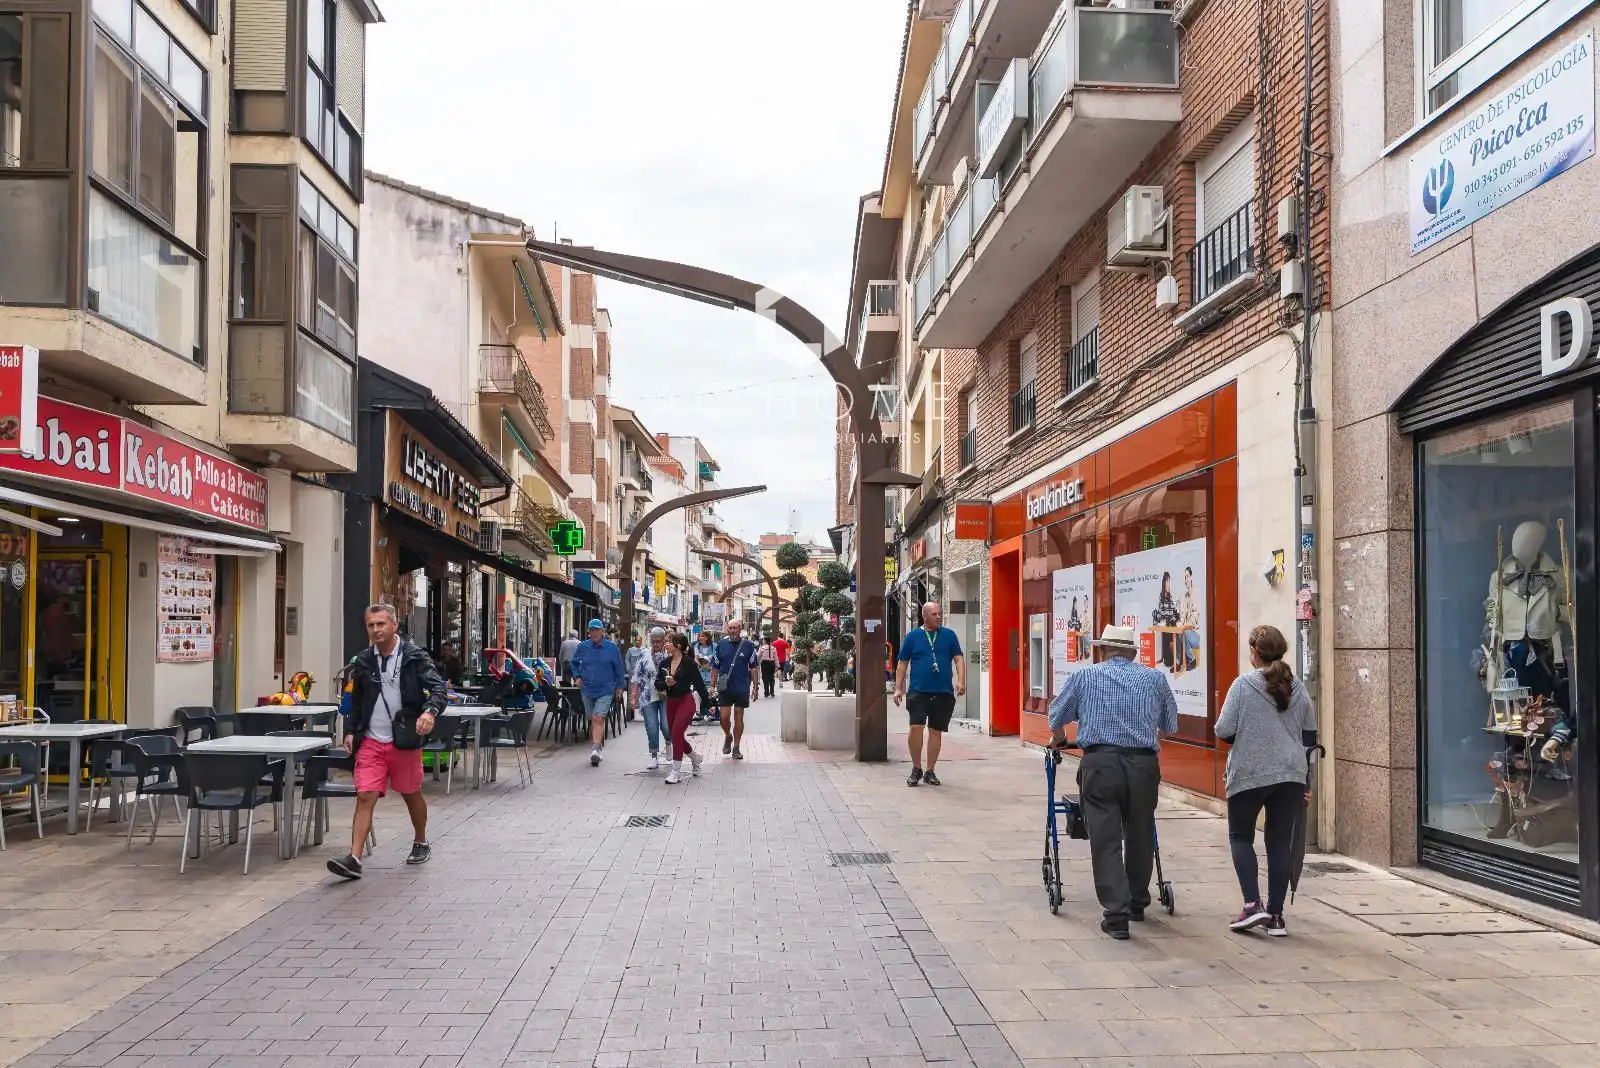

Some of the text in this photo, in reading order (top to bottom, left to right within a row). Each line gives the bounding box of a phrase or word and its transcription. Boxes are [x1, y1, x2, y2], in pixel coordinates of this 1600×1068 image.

[1439, 42, 1588, 155] CENTRO DE PSICOLOGÍA
[1469, 101, 1548, 167] PsicoEca
[1464, 179, 1480, 198] 910
[1481, 168, 1498, 189] 343
[1499, 156, 1517, 176] 091
[1524, 140, 1543, 161] 656
[1544, 127, 1564, 149] 592
[1566, 114, 1584, 136] 135
[1540, 296, 1594, 377] D
[126, 433, 193, 500] Kebab
[195, 454, 266, 505] Pollo a la Parrilla
